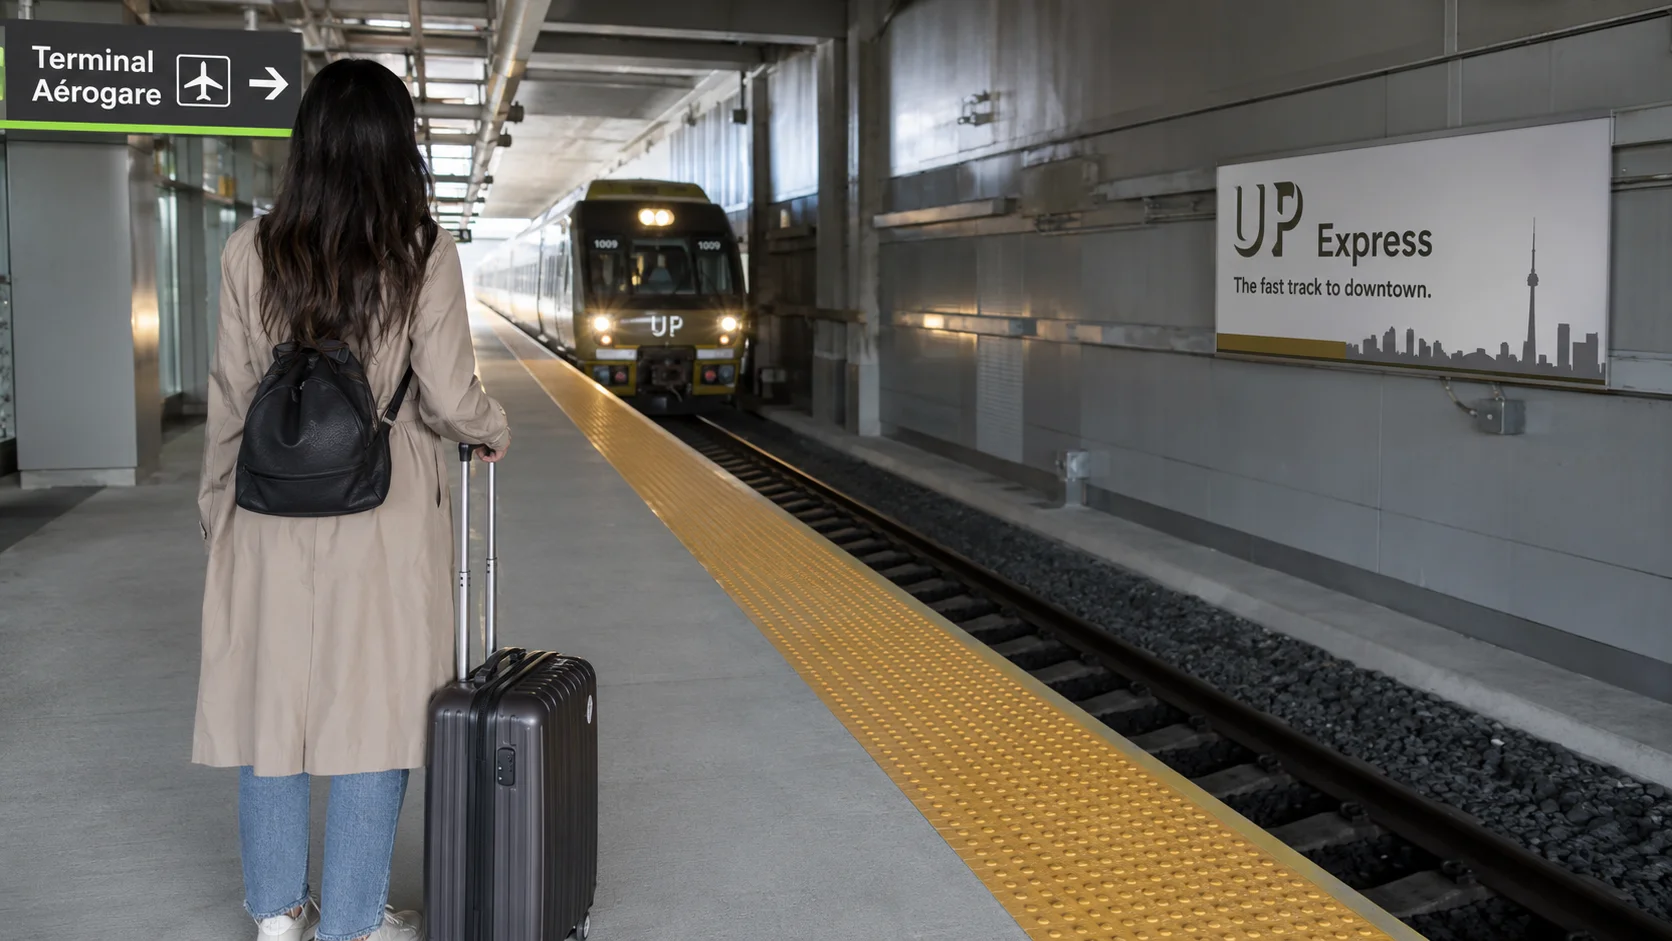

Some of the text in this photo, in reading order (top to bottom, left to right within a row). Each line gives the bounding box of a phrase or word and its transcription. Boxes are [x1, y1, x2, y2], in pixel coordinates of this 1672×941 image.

[31, 45, 154, 73] Terminal
[31, 78, 162, 110] Aérogare
[1233, 181, 1433, 267] UP Express
[594, 239, 618, 249] 1009
[698, 240, 721, 250] 1009
[1233, 276, 1432, 299] The fast track to downtown.
[651, 315, 683, 337] UP
